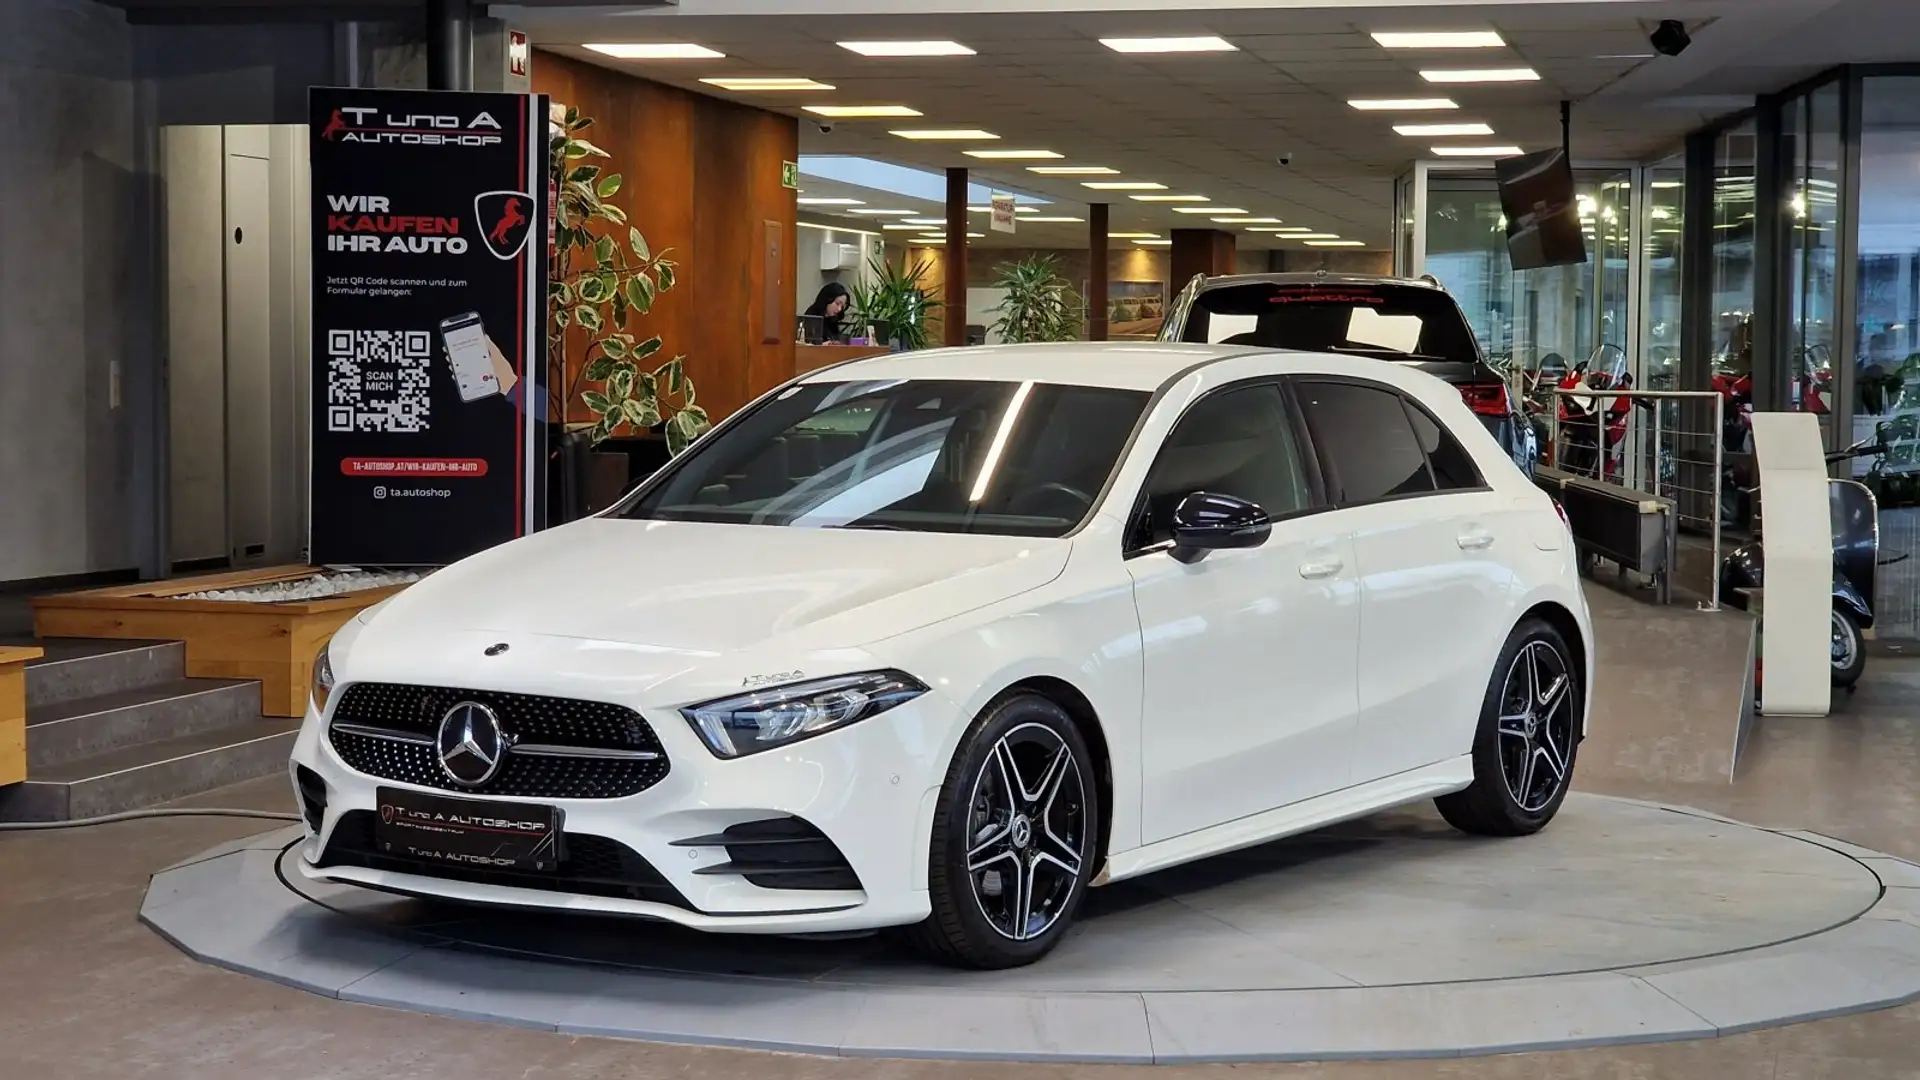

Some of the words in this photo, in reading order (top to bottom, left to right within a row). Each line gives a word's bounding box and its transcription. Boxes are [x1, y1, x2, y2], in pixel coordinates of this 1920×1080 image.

[341, 107, 378, 125] T
[467, 111, 502, 129] A
[341, 132, 502, 146] AUTOSHOP
[327, 195, 390, 213] WIR
[328, 215, 459, 233] KAUFEN
[327, 235, 381, 252] IHR
[384, 236, 468, 254] AUTO
[326, 276, 348, 285] Jetzt
[350, 276, 364, 286] QR
[365, 276, 389, 286] Code
[390, 278, 427, 286] scannen
[428, 278, 447, 287] und
[448, 279, 467, 287] zum
[326, 286, 367, 295] Formular
[365, 371, 394, 381] SCAN
[365, 381, 394, 391] MICH
[390, 487, 452, 498] ta.autoshop
[434, 813, 445, 821] A
[449, 814, 546, 831] AUTOSHOP
[433, 851, 442, 859] A
[446, 853, 516, 866] AUTOSHOP
